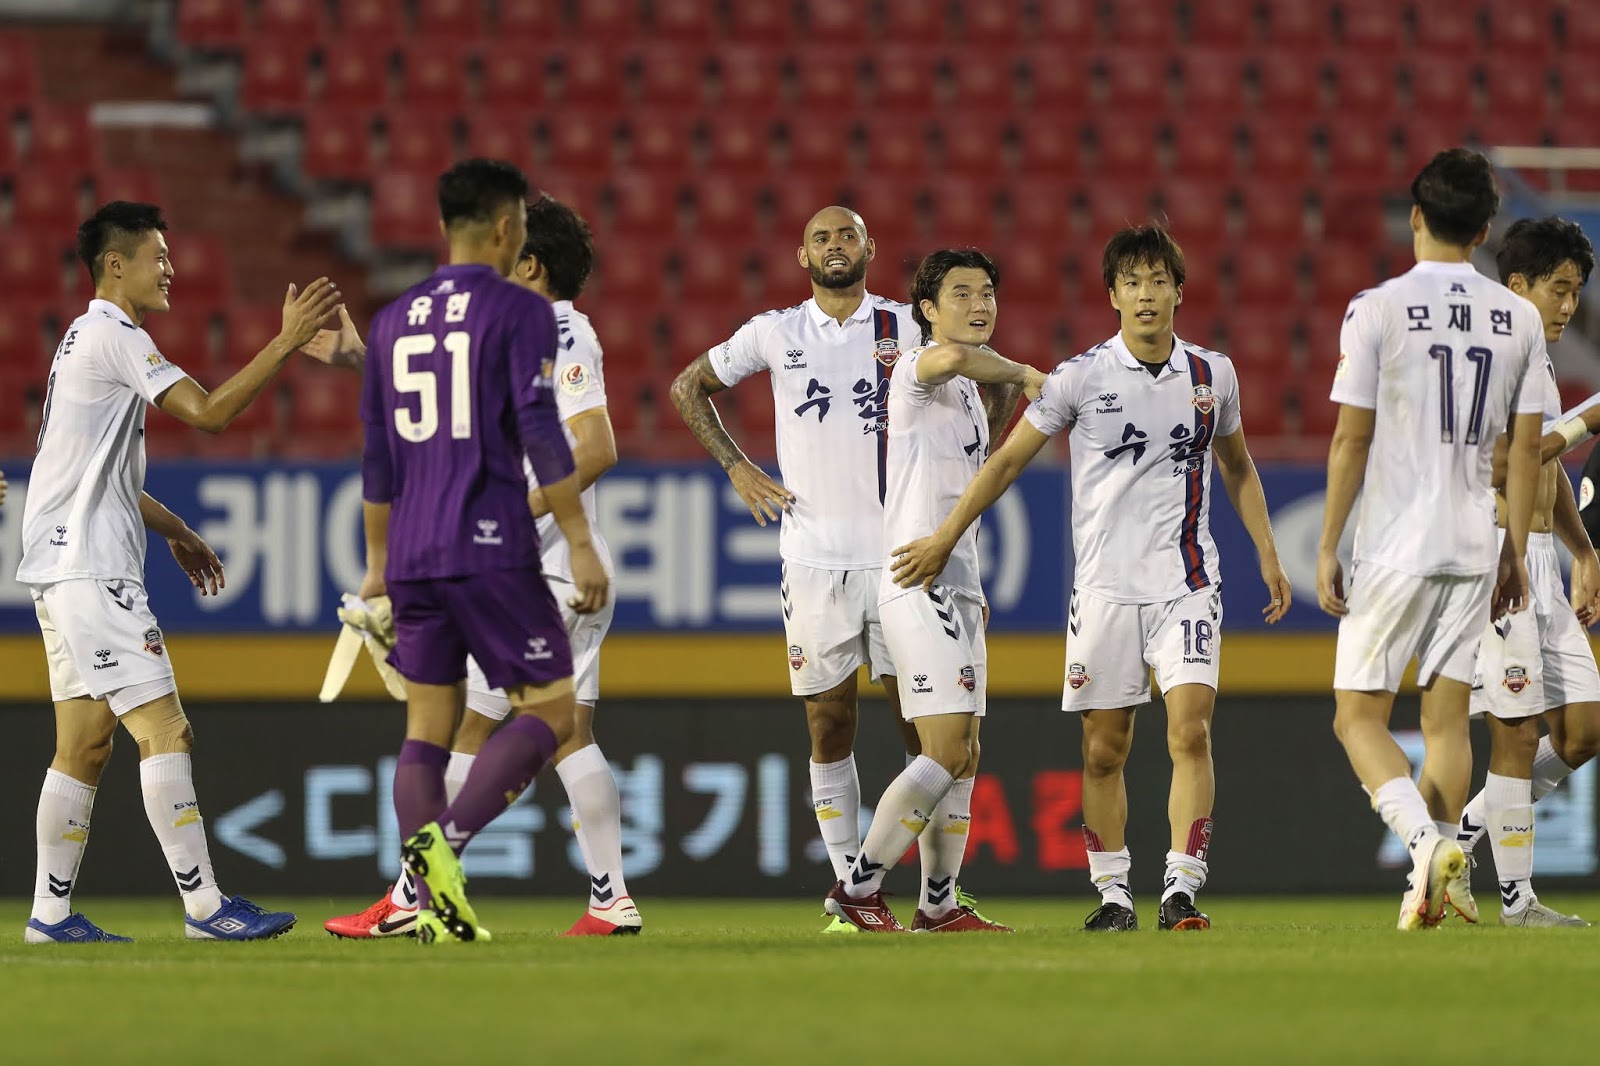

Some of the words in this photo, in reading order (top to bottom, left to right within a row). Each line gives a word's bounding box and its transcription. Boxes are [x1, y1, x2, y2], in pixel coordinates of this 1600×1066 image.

[784, 362, 807, 370] hummel
[392, 330, 471, 443] 51
[1428, 344, 1493, 446] 11
[1096, 406, 1123, 414] hummel
[1104, 422, 1209, 467] 수원
[1180, 619, 1213, 656] 18
[93, 660, 119, 671] hummel
[1183, 656, 1211, 665] hummel
